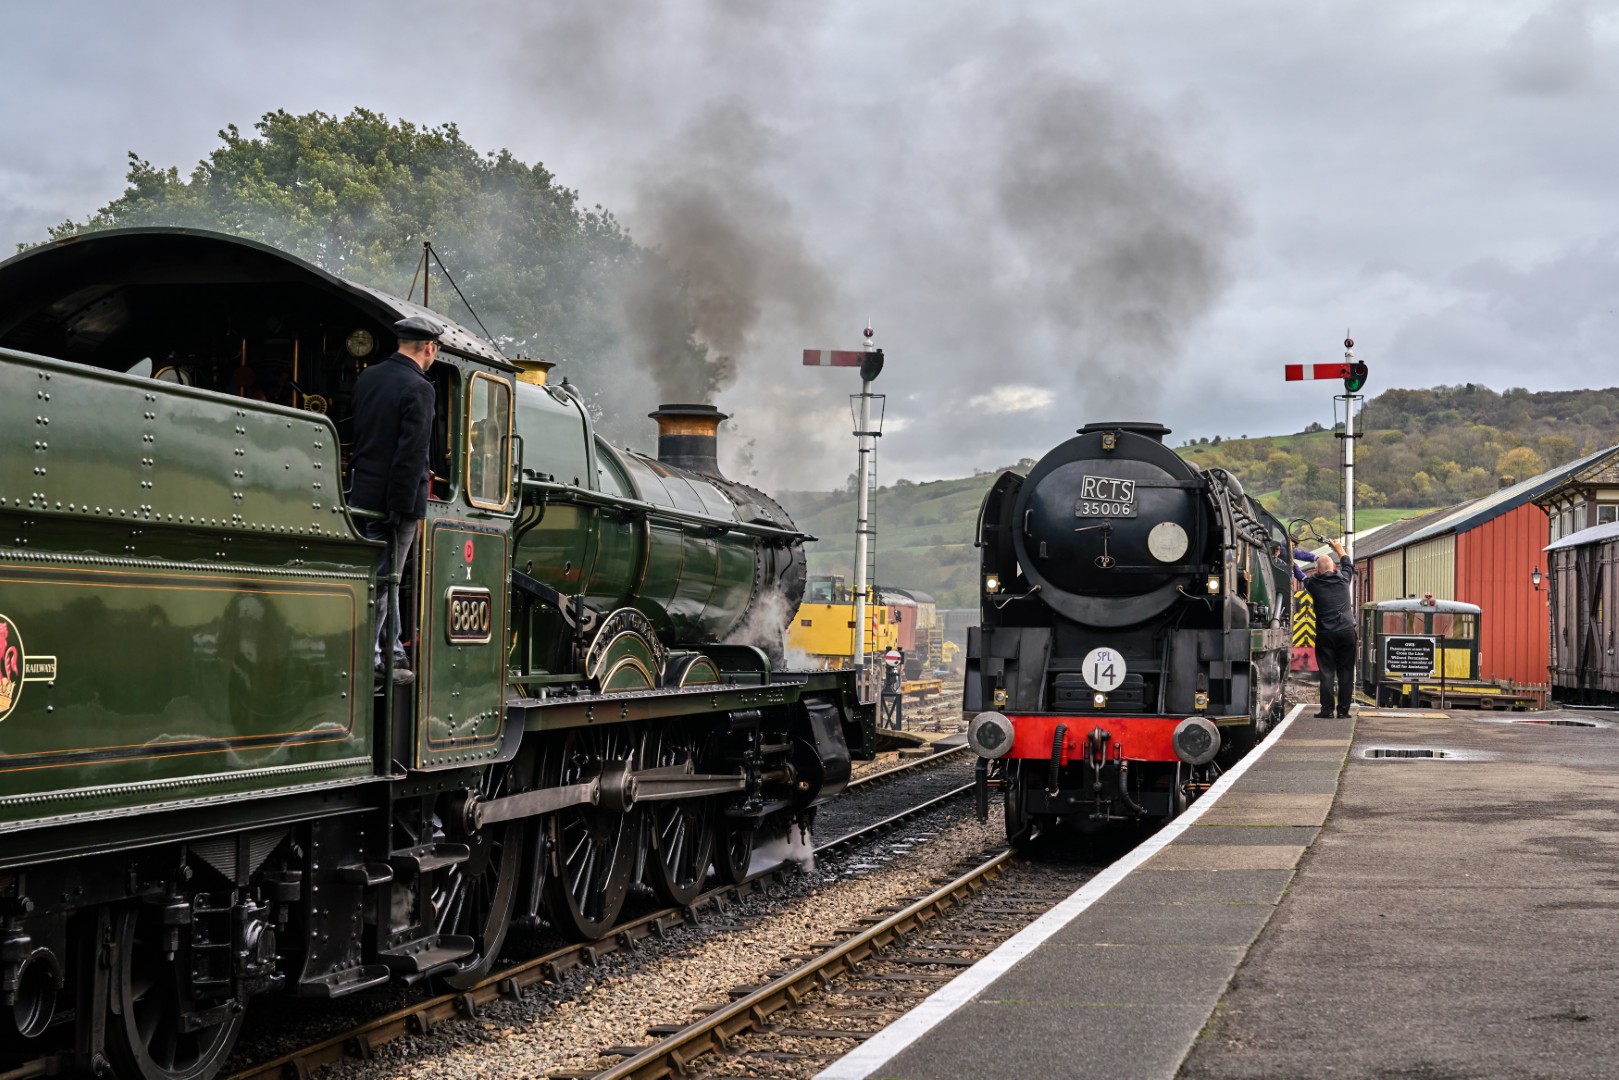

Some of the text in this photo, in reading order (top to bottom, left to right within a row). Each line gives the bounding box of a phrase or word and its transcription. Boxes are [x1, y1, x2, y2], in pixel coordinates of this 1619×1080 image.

[1084, 477, 1131, 501] RCTS
[1082, 502, 1130, 515] 35006
[466, 566, 472, 580] X
[452, 600, 489, 631] 6880
[1096, 651, 1112, 661] SPL
[25, 663, 55, 673] RAILWAYS
[1094, 662, 1117, 686] 14
